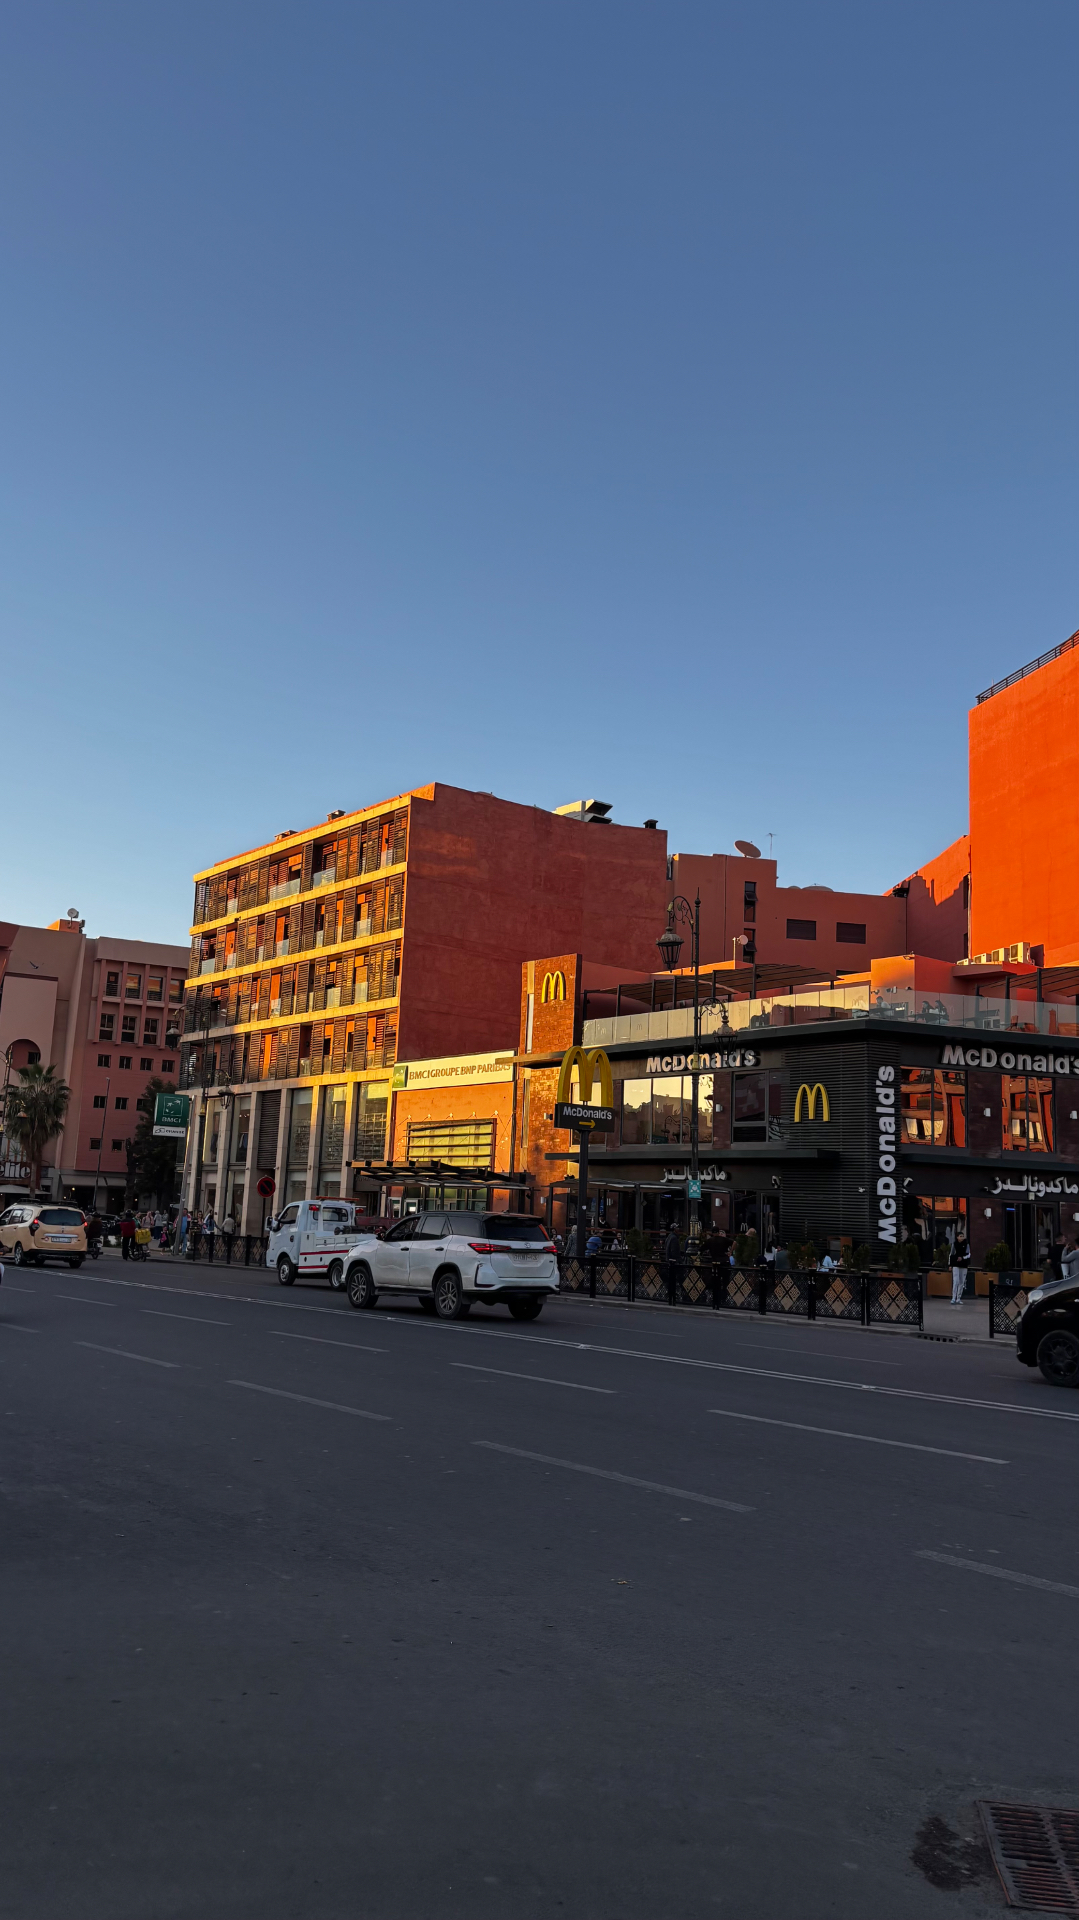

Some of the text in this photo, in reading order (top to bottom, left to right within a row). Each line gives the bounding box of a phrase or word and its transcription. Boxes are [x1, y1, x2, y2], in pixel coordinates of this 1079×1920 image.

[941, 1044, 1079, 1075] McDonald's
[409, 1070, 430, 1080] BMCI
[430, 1066, 460, 1078] GROUPE
[460, 1065, 477, 1075] BNP
[161, 1116, 182, 1124] BMCI
[563, 1106, 612, 1120] McDonald's
[876, 1065, 897, 1244] McDonald's
[991, 1174, 1079, 1198] ماكدونالدز
